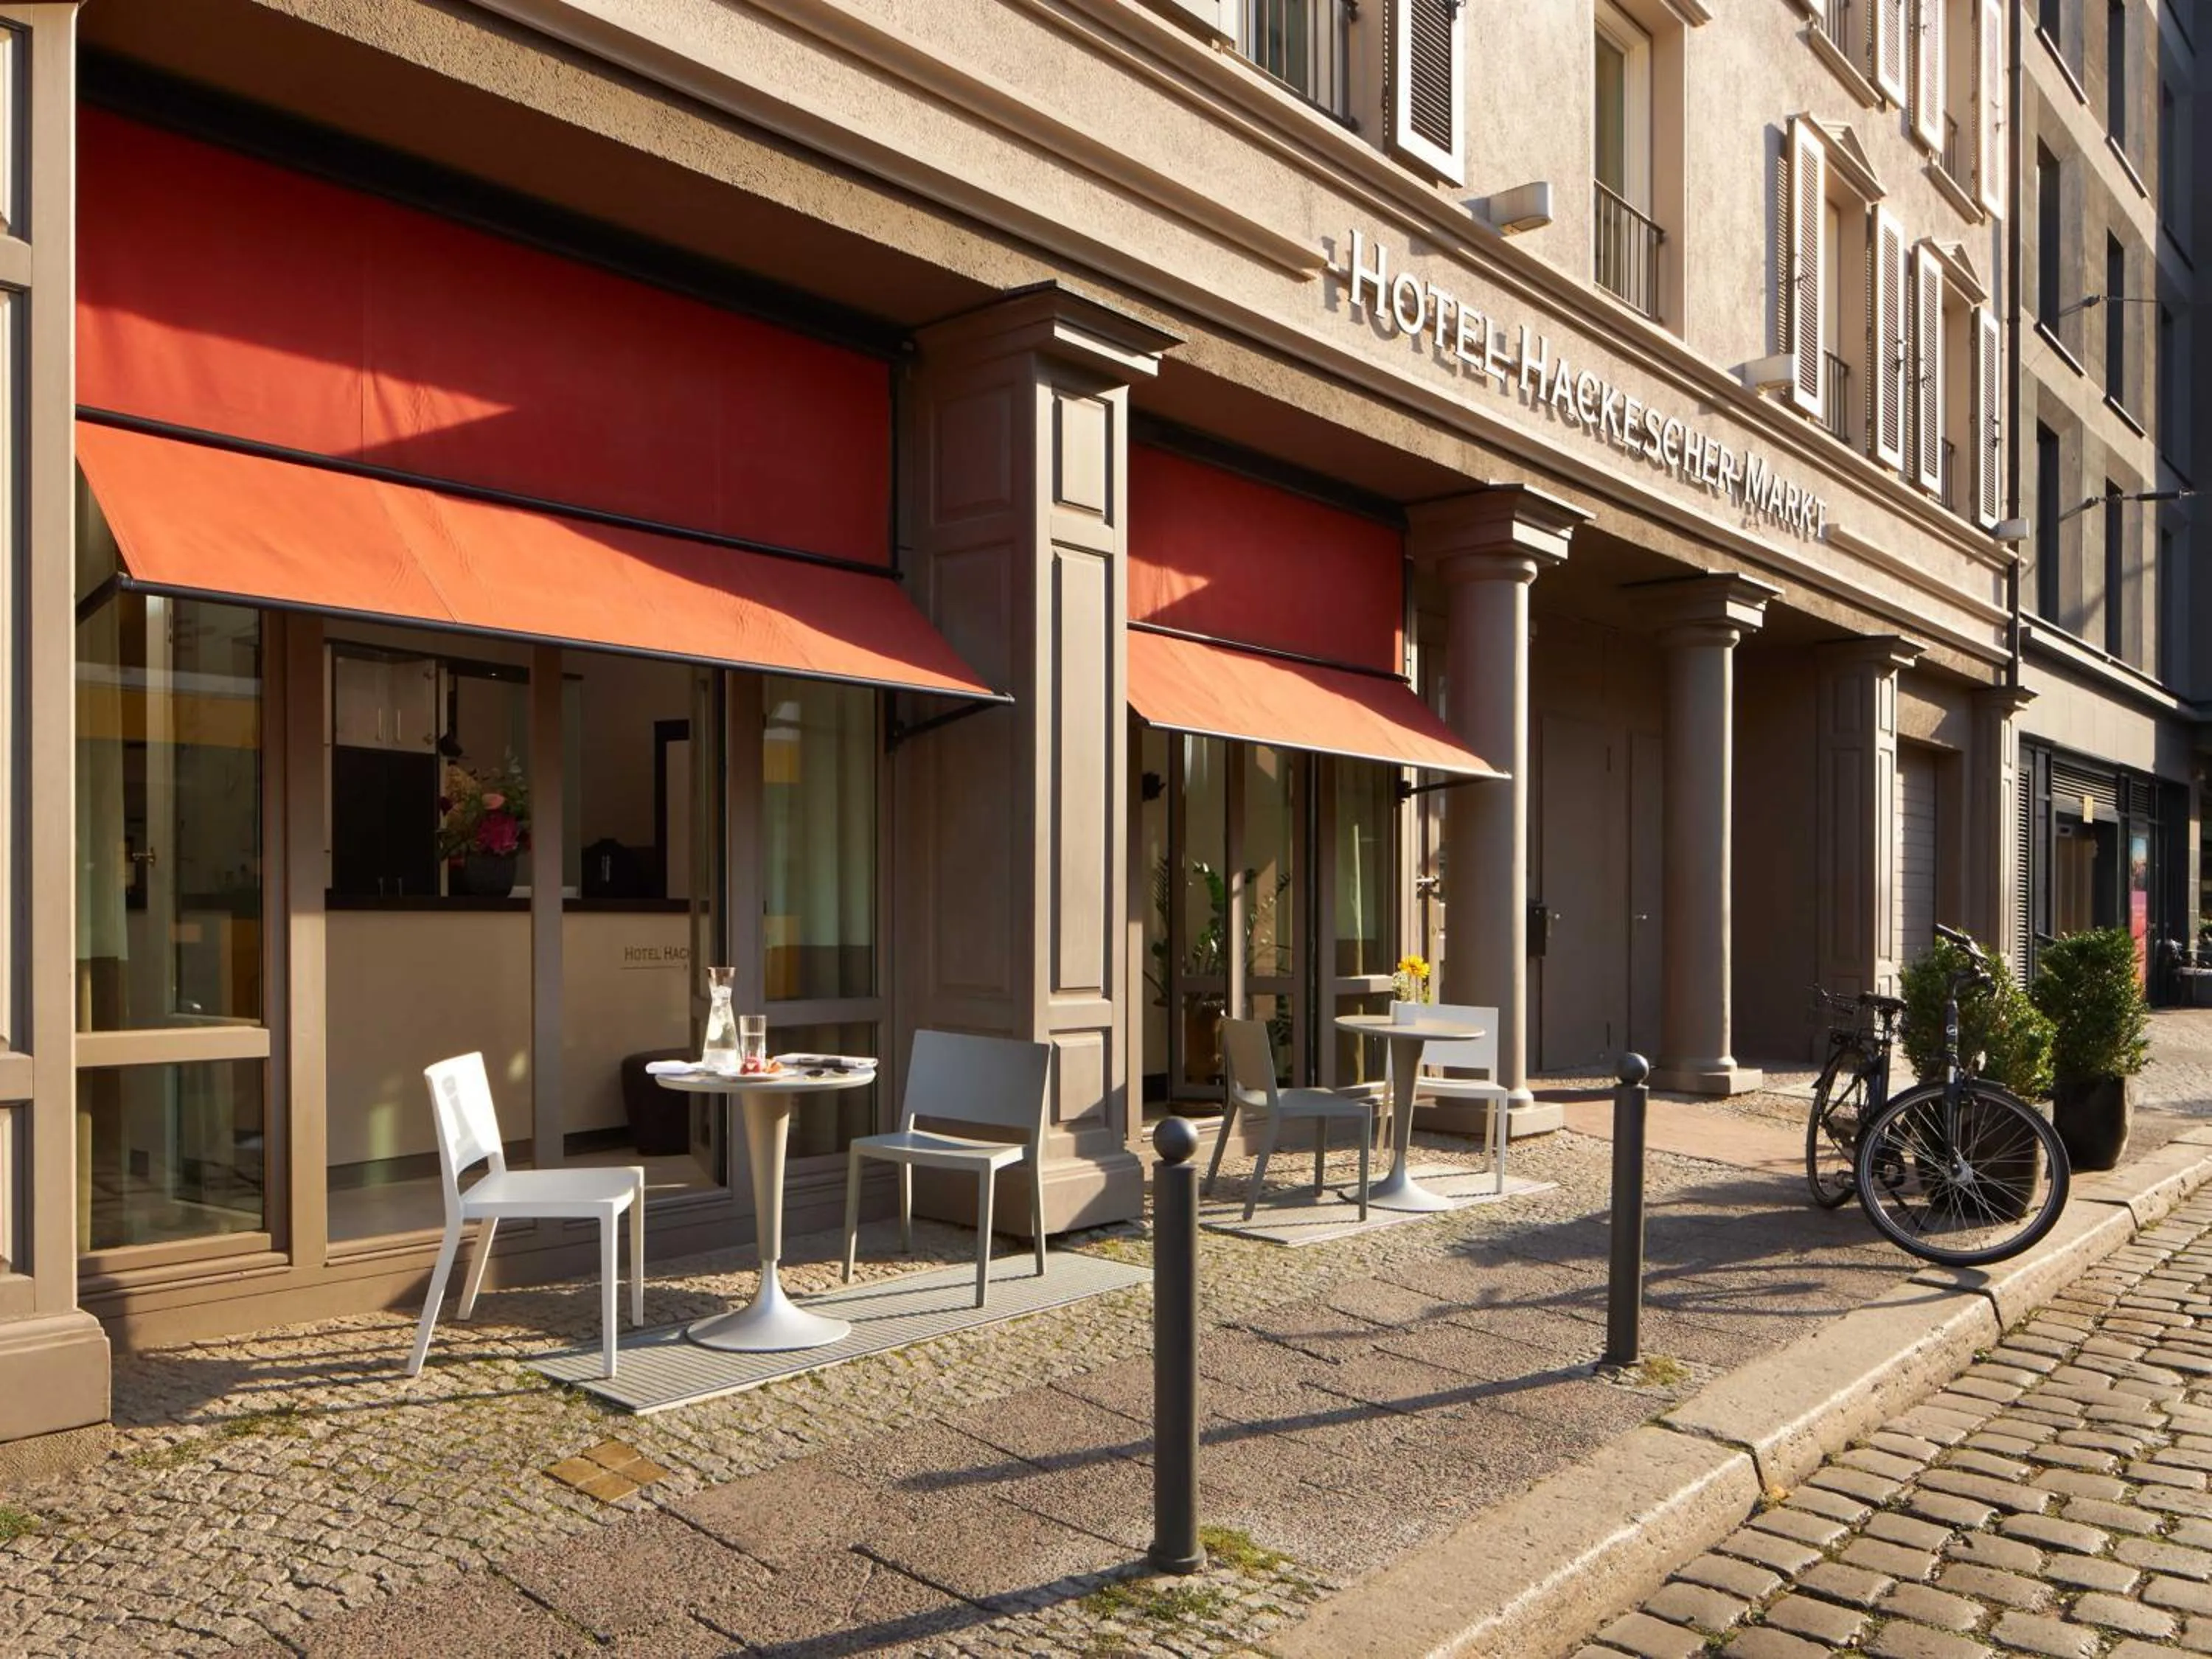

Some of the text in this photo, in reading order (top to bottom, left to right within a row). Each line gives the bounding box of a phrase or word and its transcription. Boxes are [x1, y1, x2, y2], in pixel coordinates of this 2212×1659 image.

[1349, 229, 1827, 538] HOTEL HACKESCHER MARKT
[625, 946, 661, 961] HOTEL
